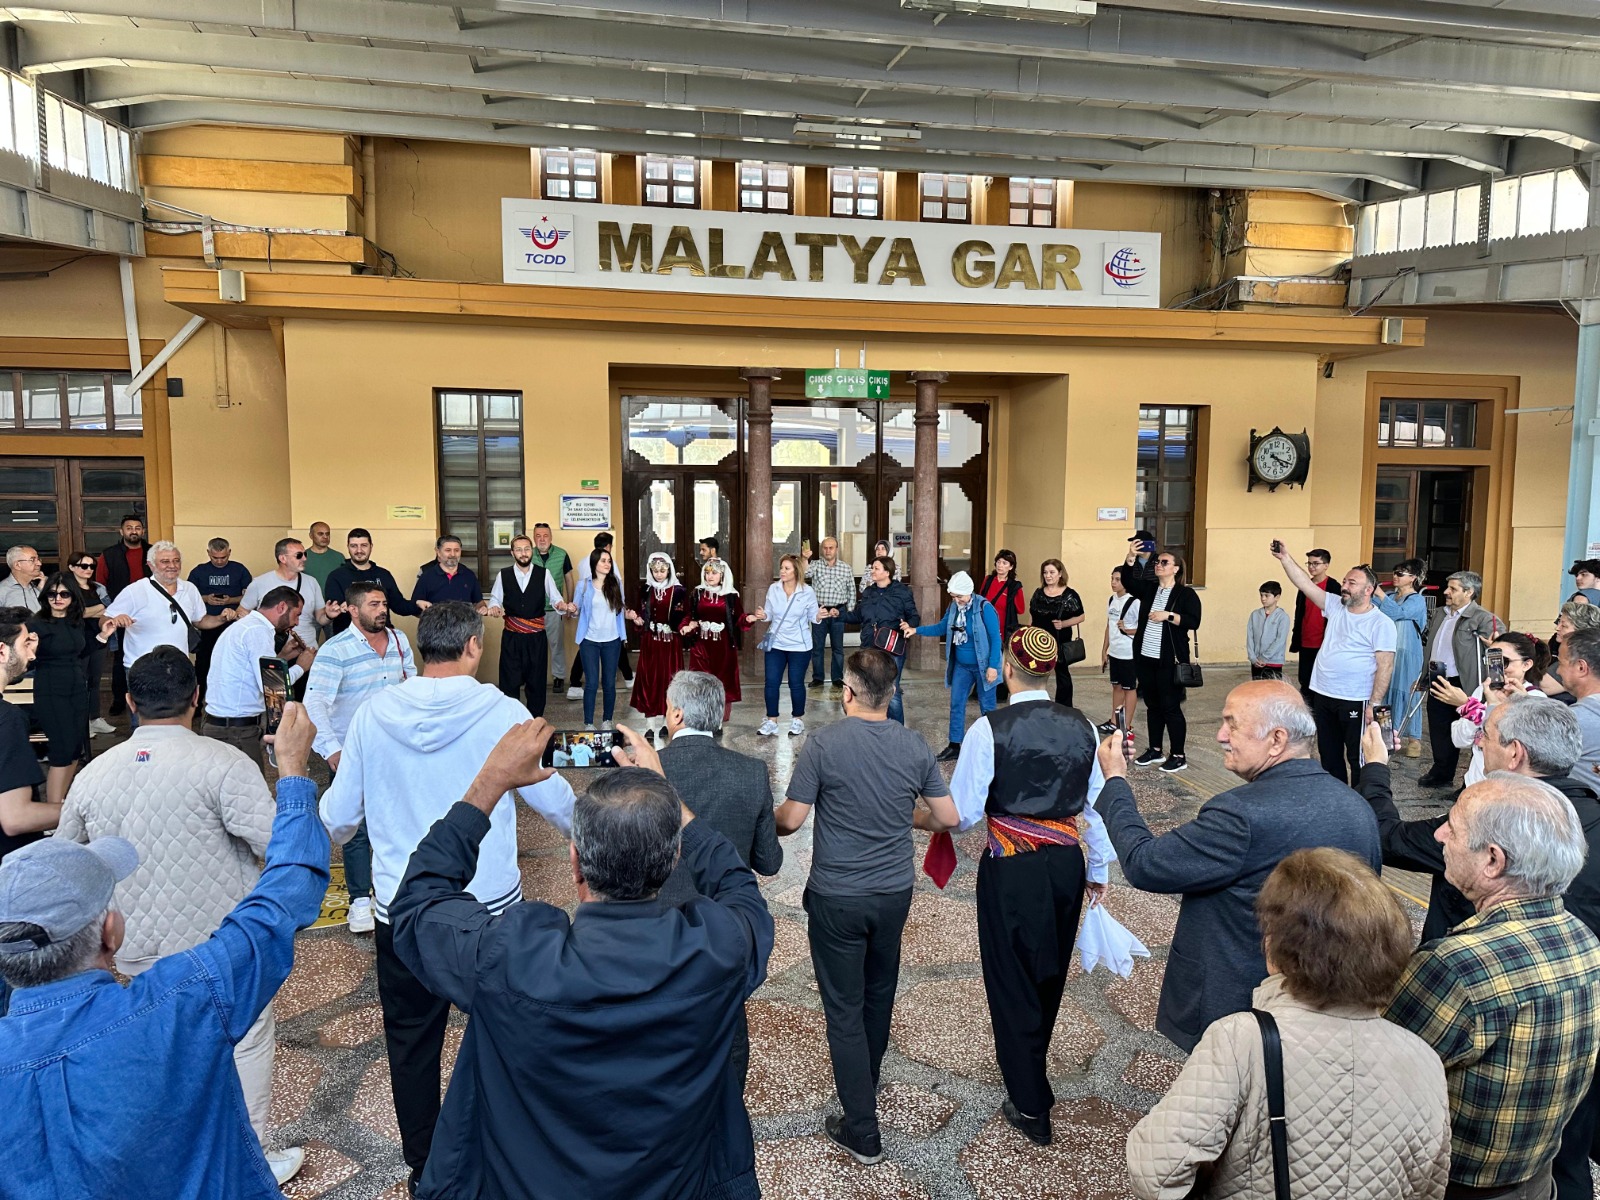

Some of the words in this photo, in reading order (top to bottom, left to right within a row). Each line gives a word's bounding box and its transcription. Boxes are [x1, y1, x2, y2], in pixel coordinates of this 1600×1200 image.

[525, 253, 566, 265] TCDD
[598, 221, 926, 286] MALATYA
[952, 240, 1083, 290] GAR
[809, 375, 833, 385] ÇIKIŞ
[868, 376, 888, 386] ÇIKIŞ
